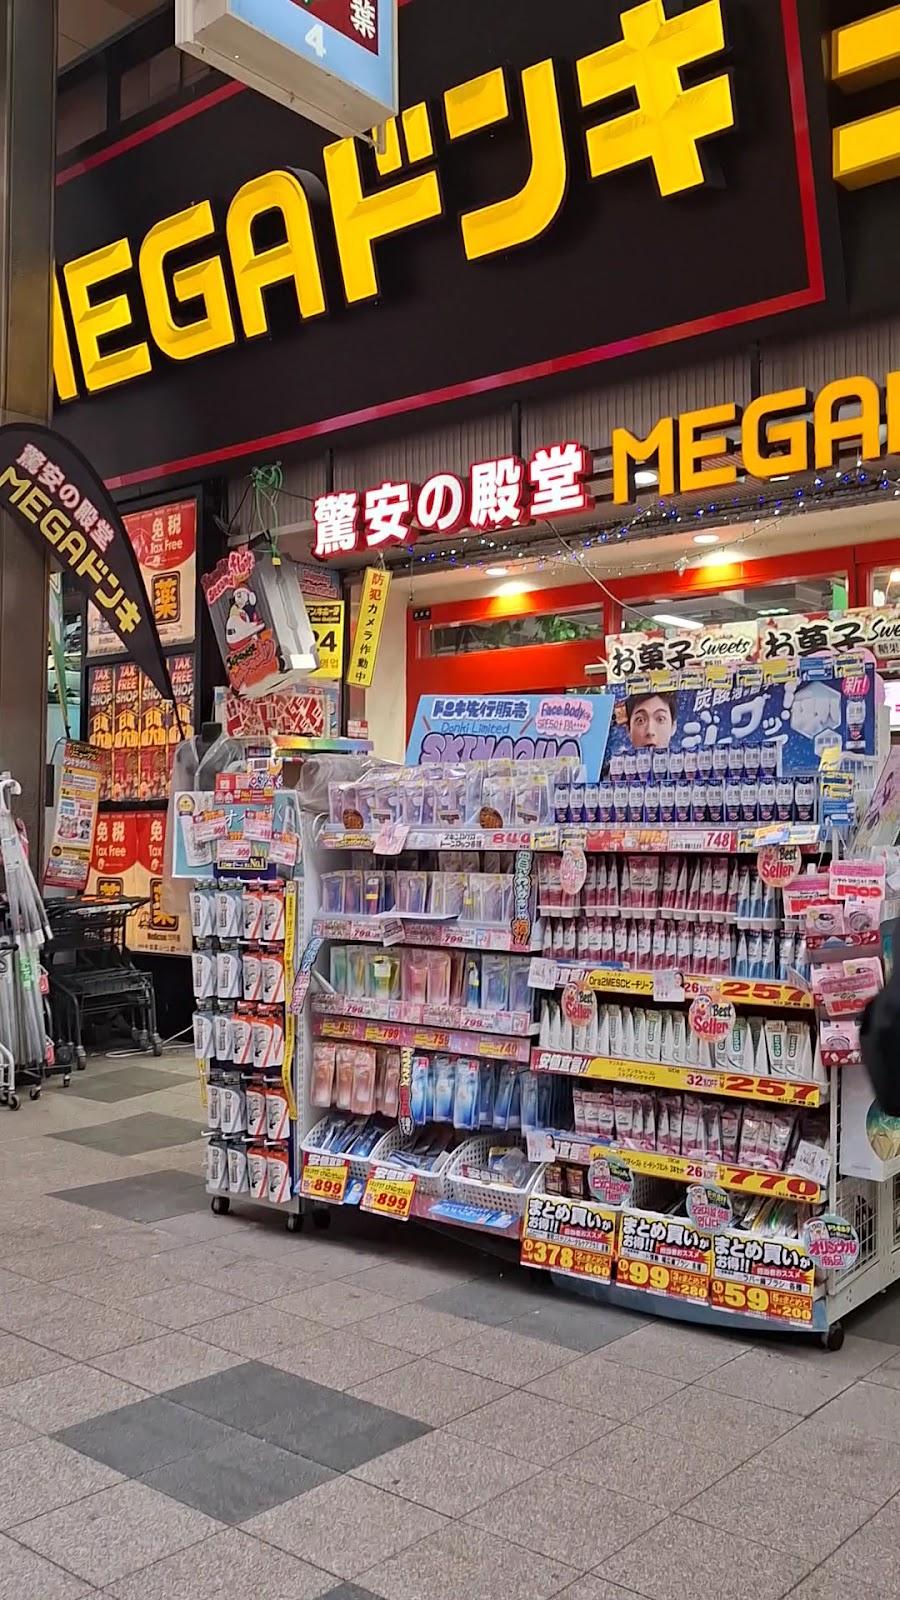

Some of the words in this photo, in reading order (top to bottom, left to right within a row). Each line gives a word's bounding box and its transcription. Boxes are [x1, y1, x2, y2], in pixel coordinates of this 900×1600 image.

[304, 24, 327, 58] 4
[612, 370, 900, 505] MEGA
[16, 443, 115, 553] 驚安の殿堂
[313, 443, 588, 556] 驚安の殿堂
[151, 513, 181, 541] 免税
[0, 466, 142, 633] MEGAドンキ
[150, 542, 163, 554] Tax
[165, 539, 183, 550] Free
[154, 577, 178, 619] 薬
[355, 572, 385, 682] 防犯カメラ作動中
[765, 622, 866, 659] お菓子
[174, 657, 191, 669] TAX
[612, 640, 695, 676] お菓子
[696, 637, 750, 658] Sweets
[94, 669, 110, 681] TAX
[121, 665, 136, 677] TAX
[171, 670, 194, 683] FREE
[92, 681, 112, 694] FREE
[117, 678, 138, 691] FREE
[90, 694, 113, 706] SHOP
[115, 691, 139, 704] SHOP
[142, 688, 162, 701] SHO
[434, 699, 530, 719] ドンキ先行販売
[441, 722, 470, 734] Donki
[472, 723, 510, 734] Limited
[97, 821, 125, 842] 免税
[707, 833, 730, 847] 748
[95, 845, 108, 856] Tax
[109, 845, 127, 856] Free
[779, 851, 798, 862] Best
[761, 862, 794, 879] Seller
[578, 989, 593, 1004] Best
[720, 980, 805, 1001] 257
[565, 1001, 592, 1019] Seller
[712, 1003, 732, 1017] Best
[693, 1014, 729, 1034] Seller
[725, 1076, 819, 1099] 257
[314, 1180, 342, 1195] 899
[726, 1168, 819, 1196] 770
[377, 1193, 408, 1210] 899
[529, 1199, 613, 1232] まとめ買いが
[529, 1216, 559, 1232] お得!!
[623, 1216, 710, 1250] まとめ買いが
[623, 1235, 654, 1252] お得!!
[714, 1236, 811, 1268] まとめ買いが
[534, 1241, 574, 1268] 378
[715, 1254, 749, 1273] お得!!
[629, 1261, 670, 1289] 99
[680, 1284, 708, 1298] 280
[724, 1281, 769, 1312] 59
[782, 1306, 812, 1320] 200
